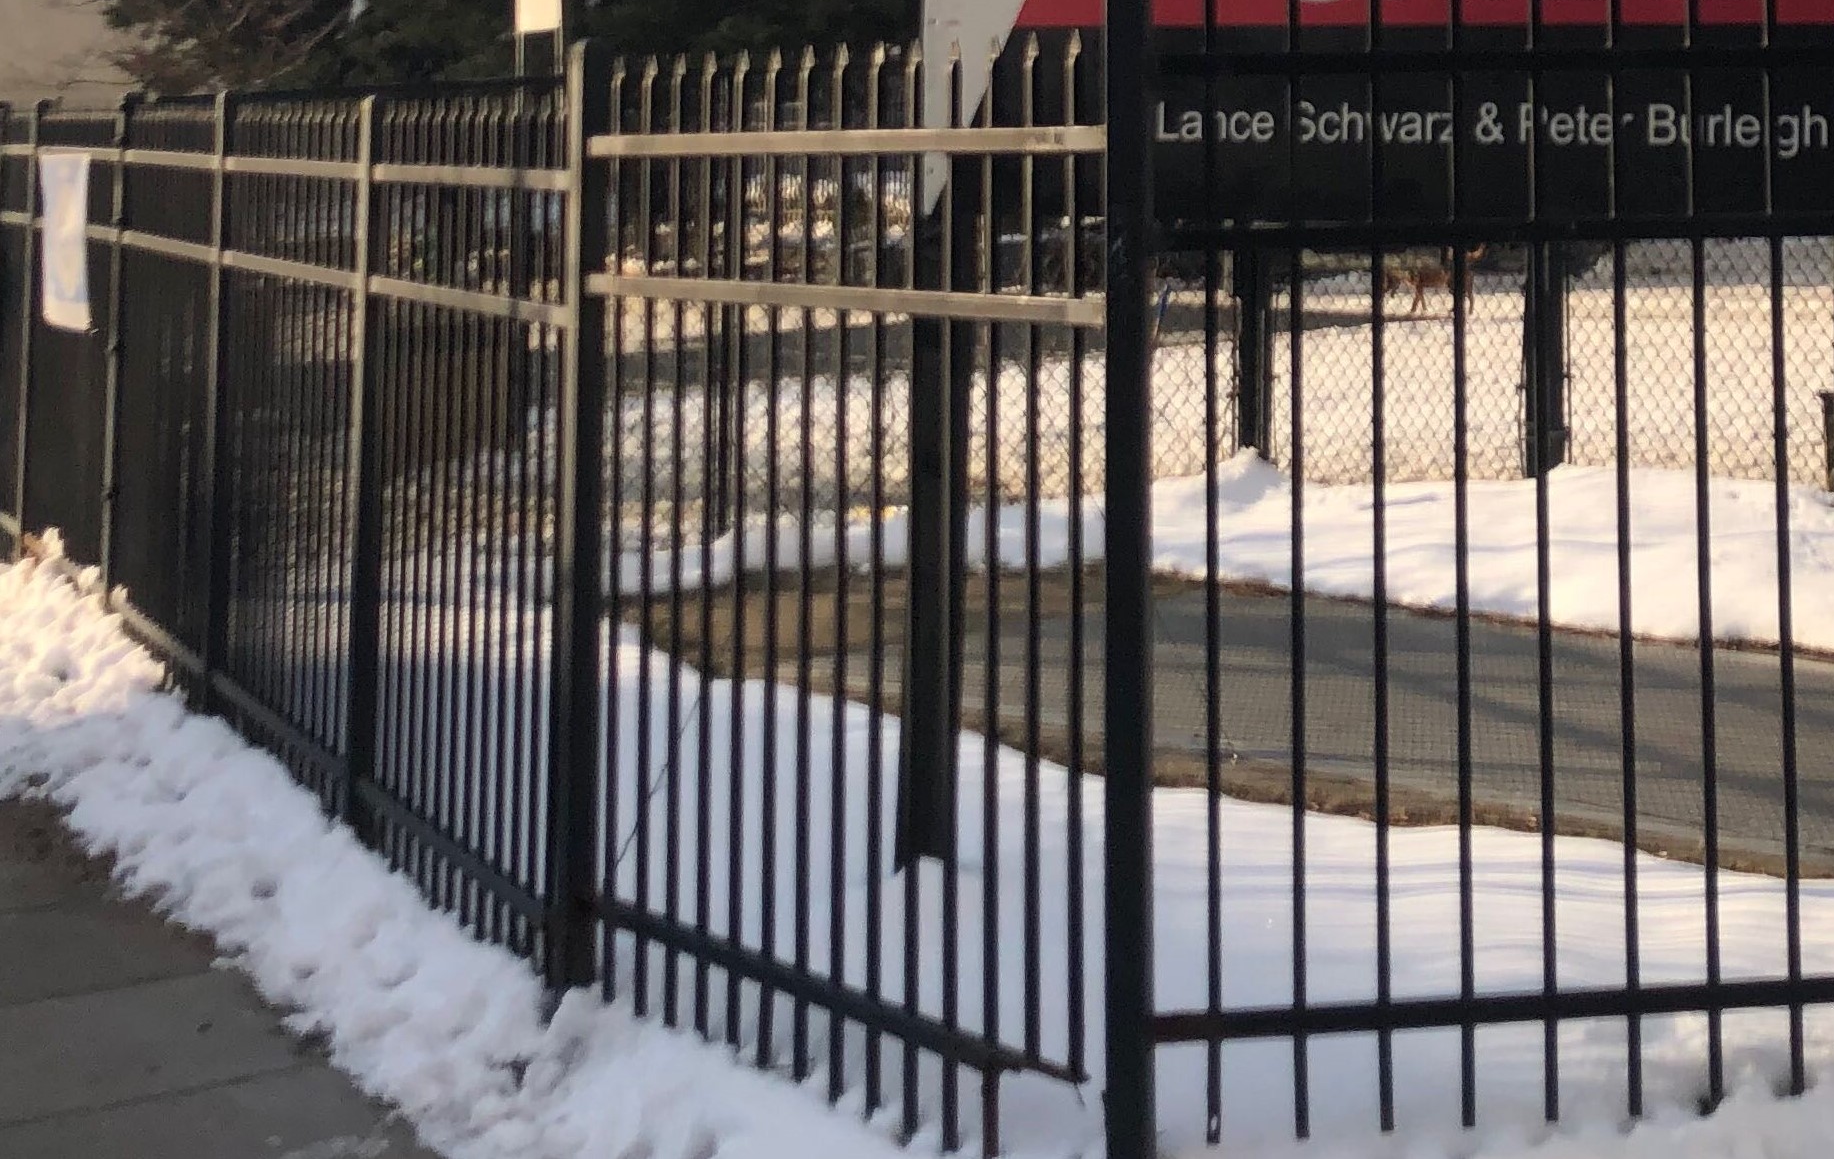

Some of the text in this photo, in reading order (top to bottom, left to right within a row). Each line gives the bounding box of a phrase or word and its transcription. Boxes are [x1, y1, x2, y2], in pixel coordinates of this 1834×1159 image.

[1155, 100, 1275, 142] Lance
[1475, 101, 1505, 144] &
[1647, 102, 1829, 158] Burlegh
